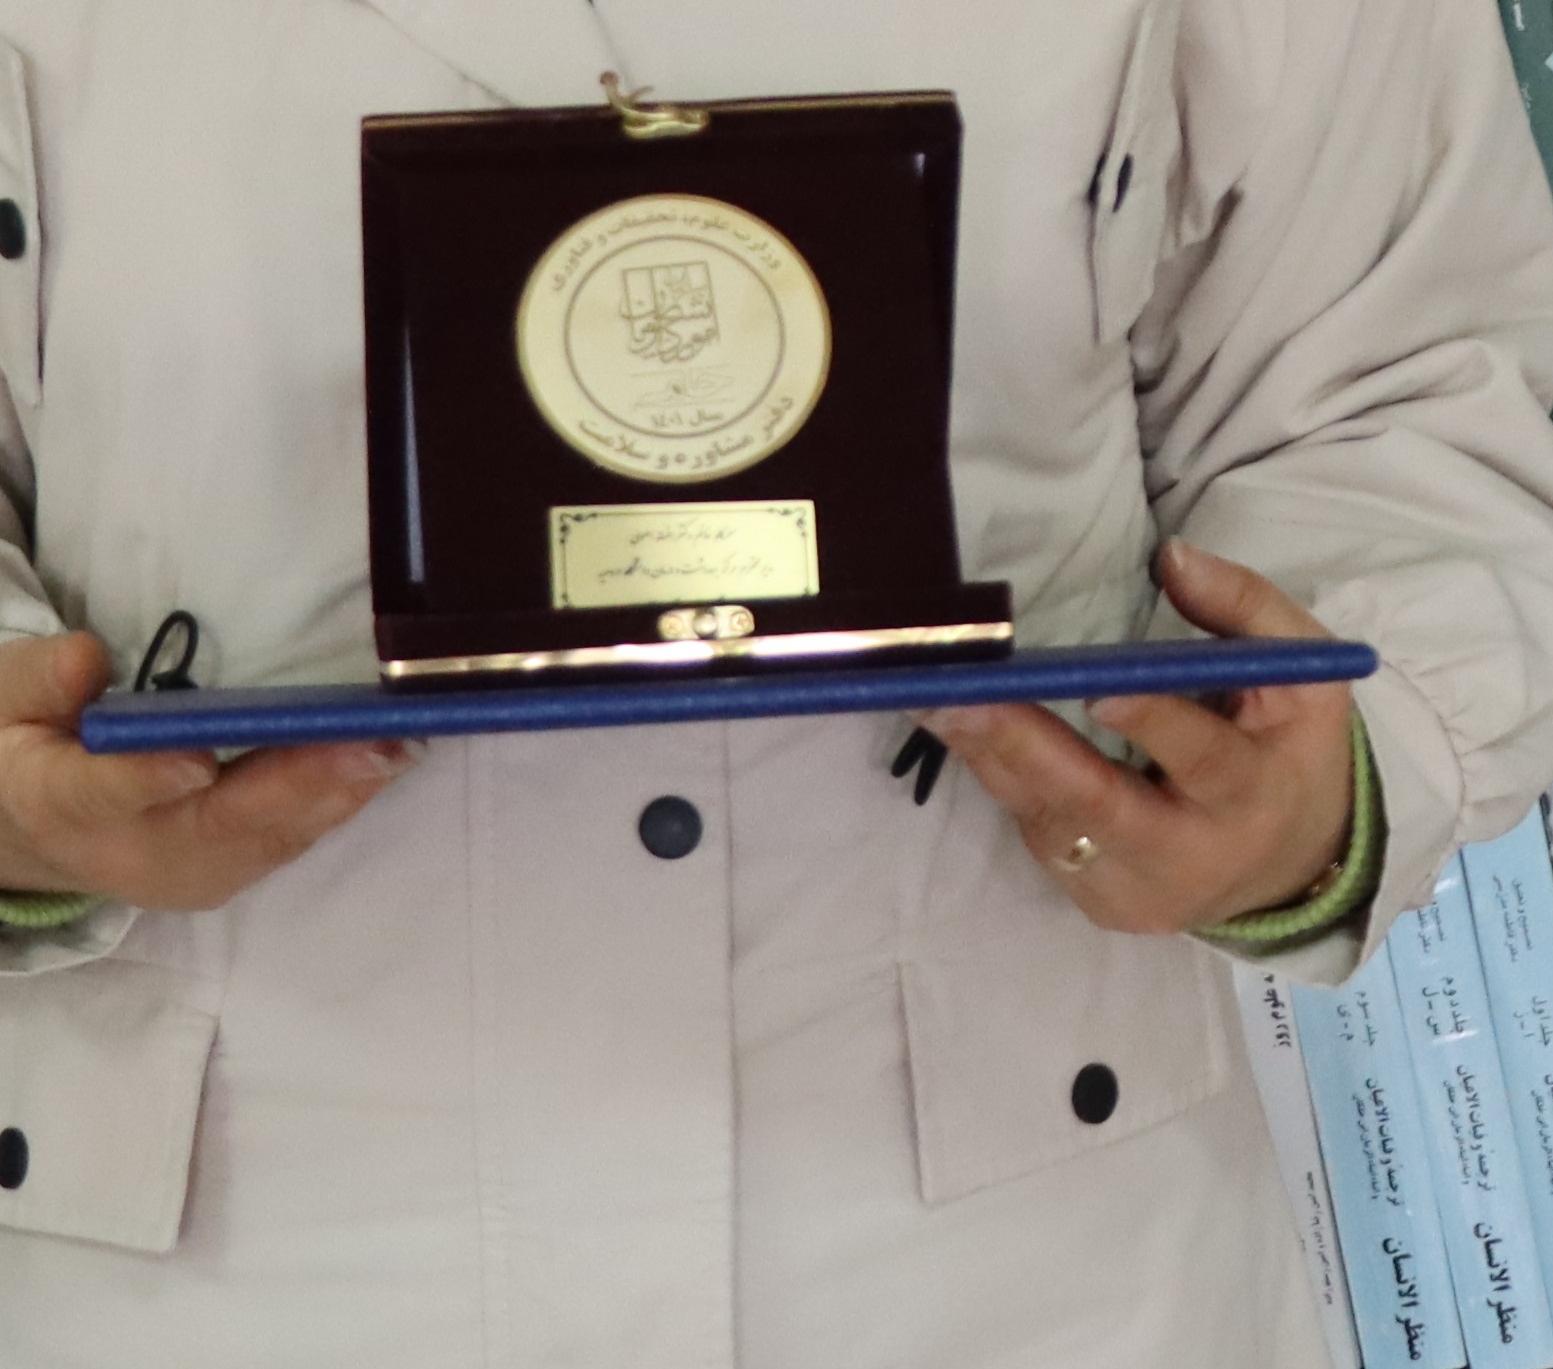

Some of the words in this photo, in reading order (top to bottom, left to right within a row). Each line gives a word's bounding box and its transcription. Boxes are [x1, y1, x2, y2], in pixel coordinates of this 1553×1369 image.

[1381, 1234, 1420, 1309] الانسان
[1473, 1219, 1512, 1294] الانسان
[1394, 1310, 1429, 1362] منظر
[1485, 1293, 1523, 1346] منظر
